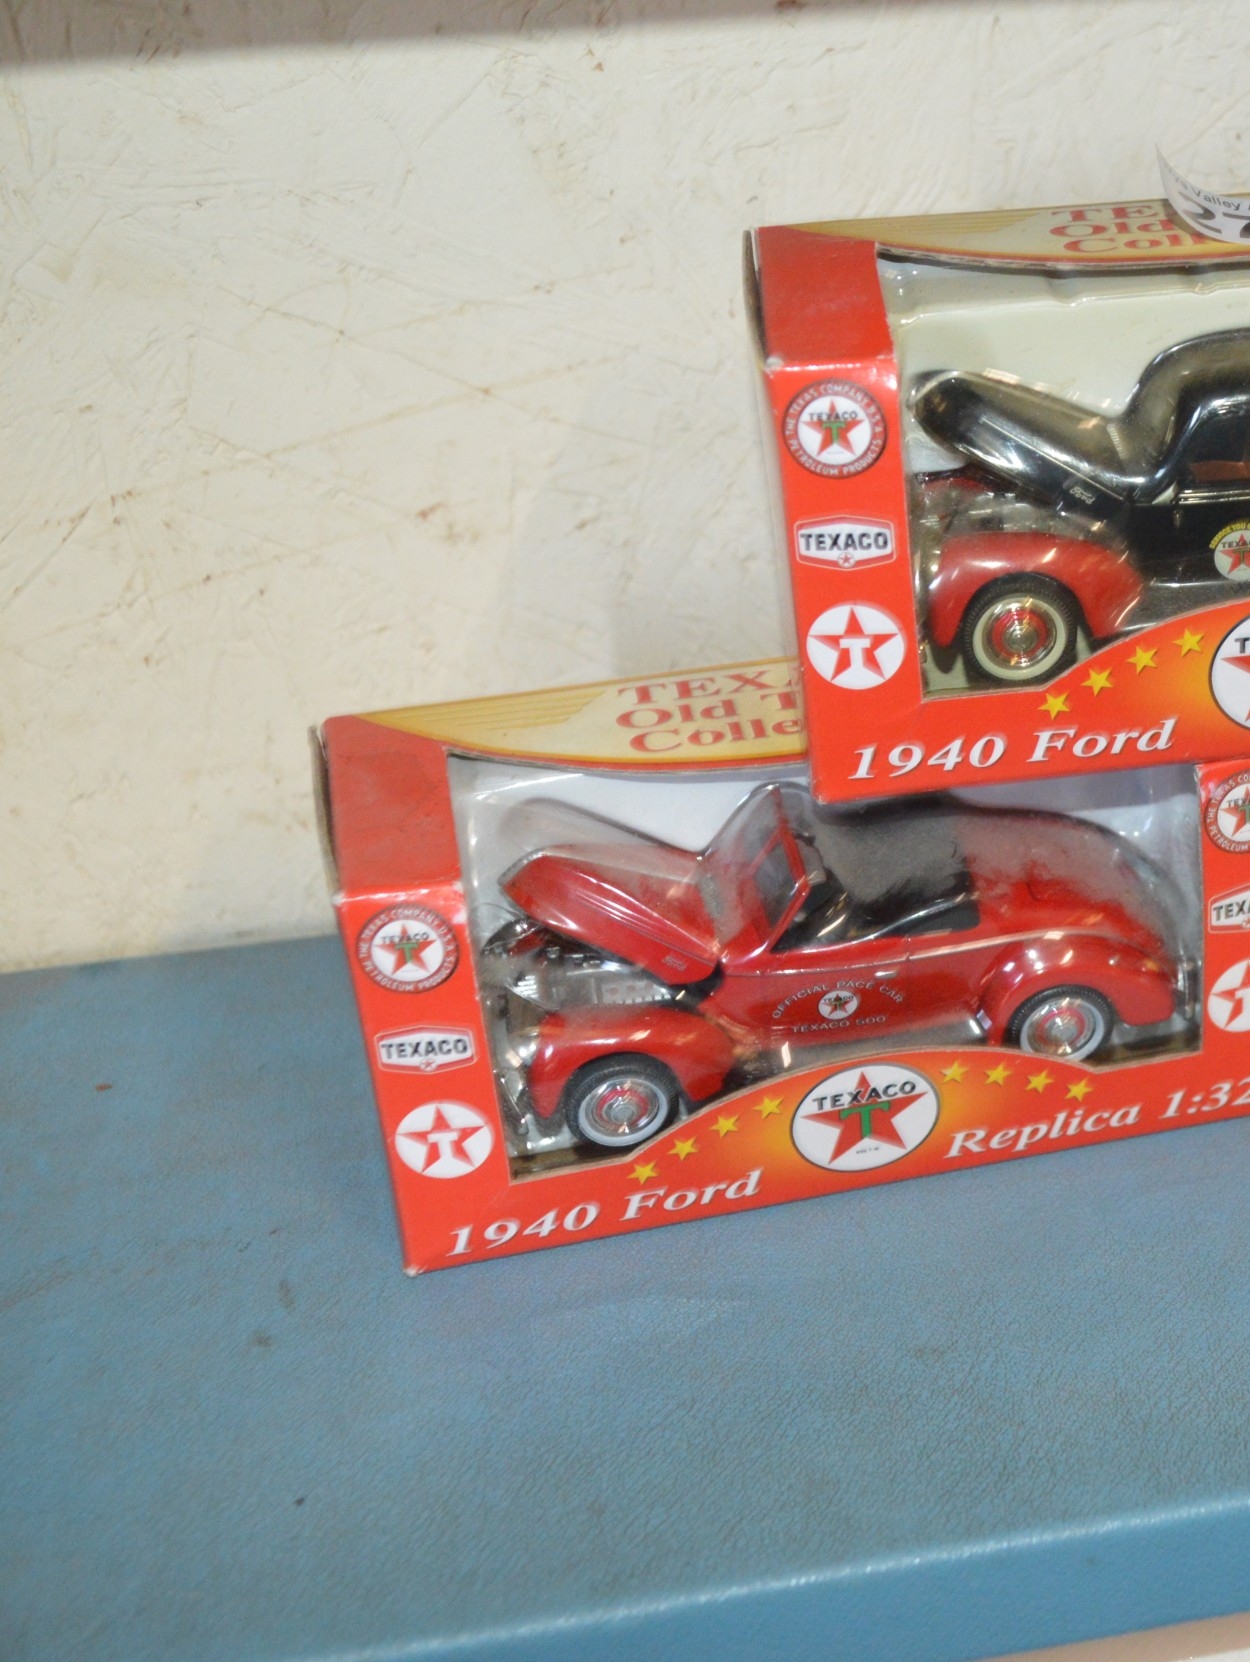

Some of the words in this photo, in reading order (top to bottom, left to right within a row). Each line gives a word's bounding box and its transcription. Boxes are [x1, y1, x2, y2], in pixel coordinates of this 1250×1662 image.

[1191, 187, 1241, 212] Valley
[1050, 219, 1176, 237] Old
[808, 410, 858, 421] TEXACO
[800, 529, 889, 553] TEXACO
[615, 698, 740, 729] Old
[847, 734, 1007, 780] 1940
[1025, 715, 1179, 764] Ford
[1207, 807, 1215, 823] THE
[1209, 825, 1248, 851] PETROLEUM
[772, 984, 829, 1019] OFFICIAL
[837, 980, 875, 989] PACE
[879, 984, 904, 1004] CAR
[792, 1020, 850, 1033] TEXACO
[856, 1015, 886, 1026] 500
[379, 1034, 469, 1061] TEXACO
[811, 1080, 917, 1112] TEXACO
[839, 1100, 891, 1139] T
[942, 1104, 1143, 1159] Replica
[445, 1202, 601, 1257] 1940
[618, 1167, 765, 1222] Ford
